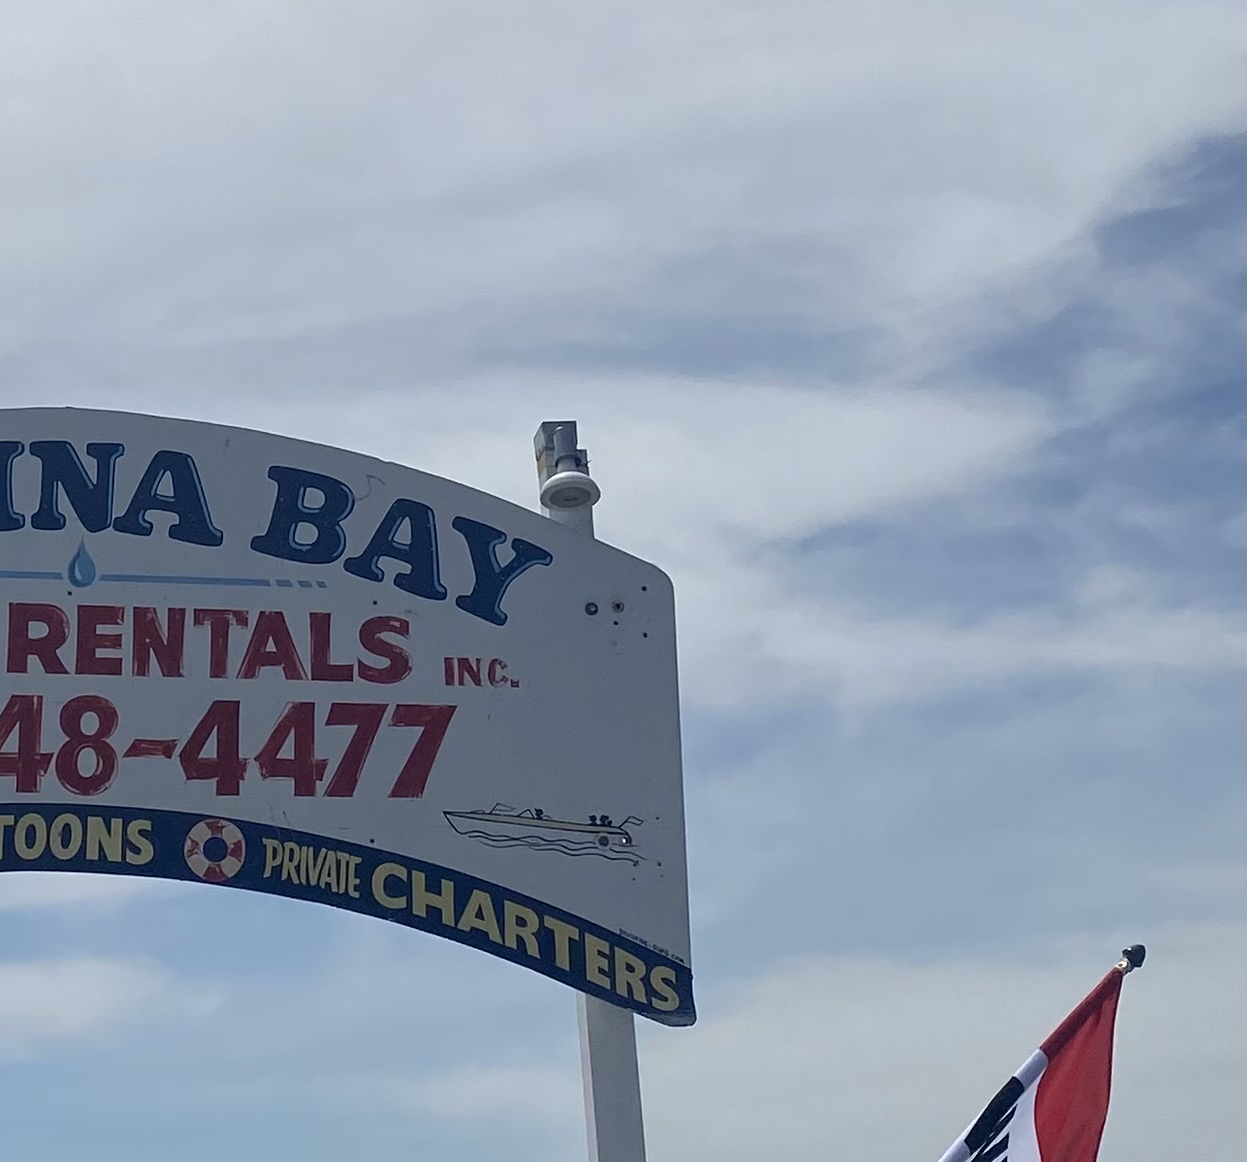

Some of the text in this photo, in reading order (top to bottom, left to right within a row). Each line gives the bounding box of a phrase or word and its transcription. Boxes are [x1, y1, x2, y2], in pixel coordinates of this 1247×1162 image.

[251, 465, 553, 627] BAY
[6, 602, 413, 684] RENTALS
[444, 656, 520, 688] INC.
[262, 837, 680, 1013] PRIVATE CHARTERS
